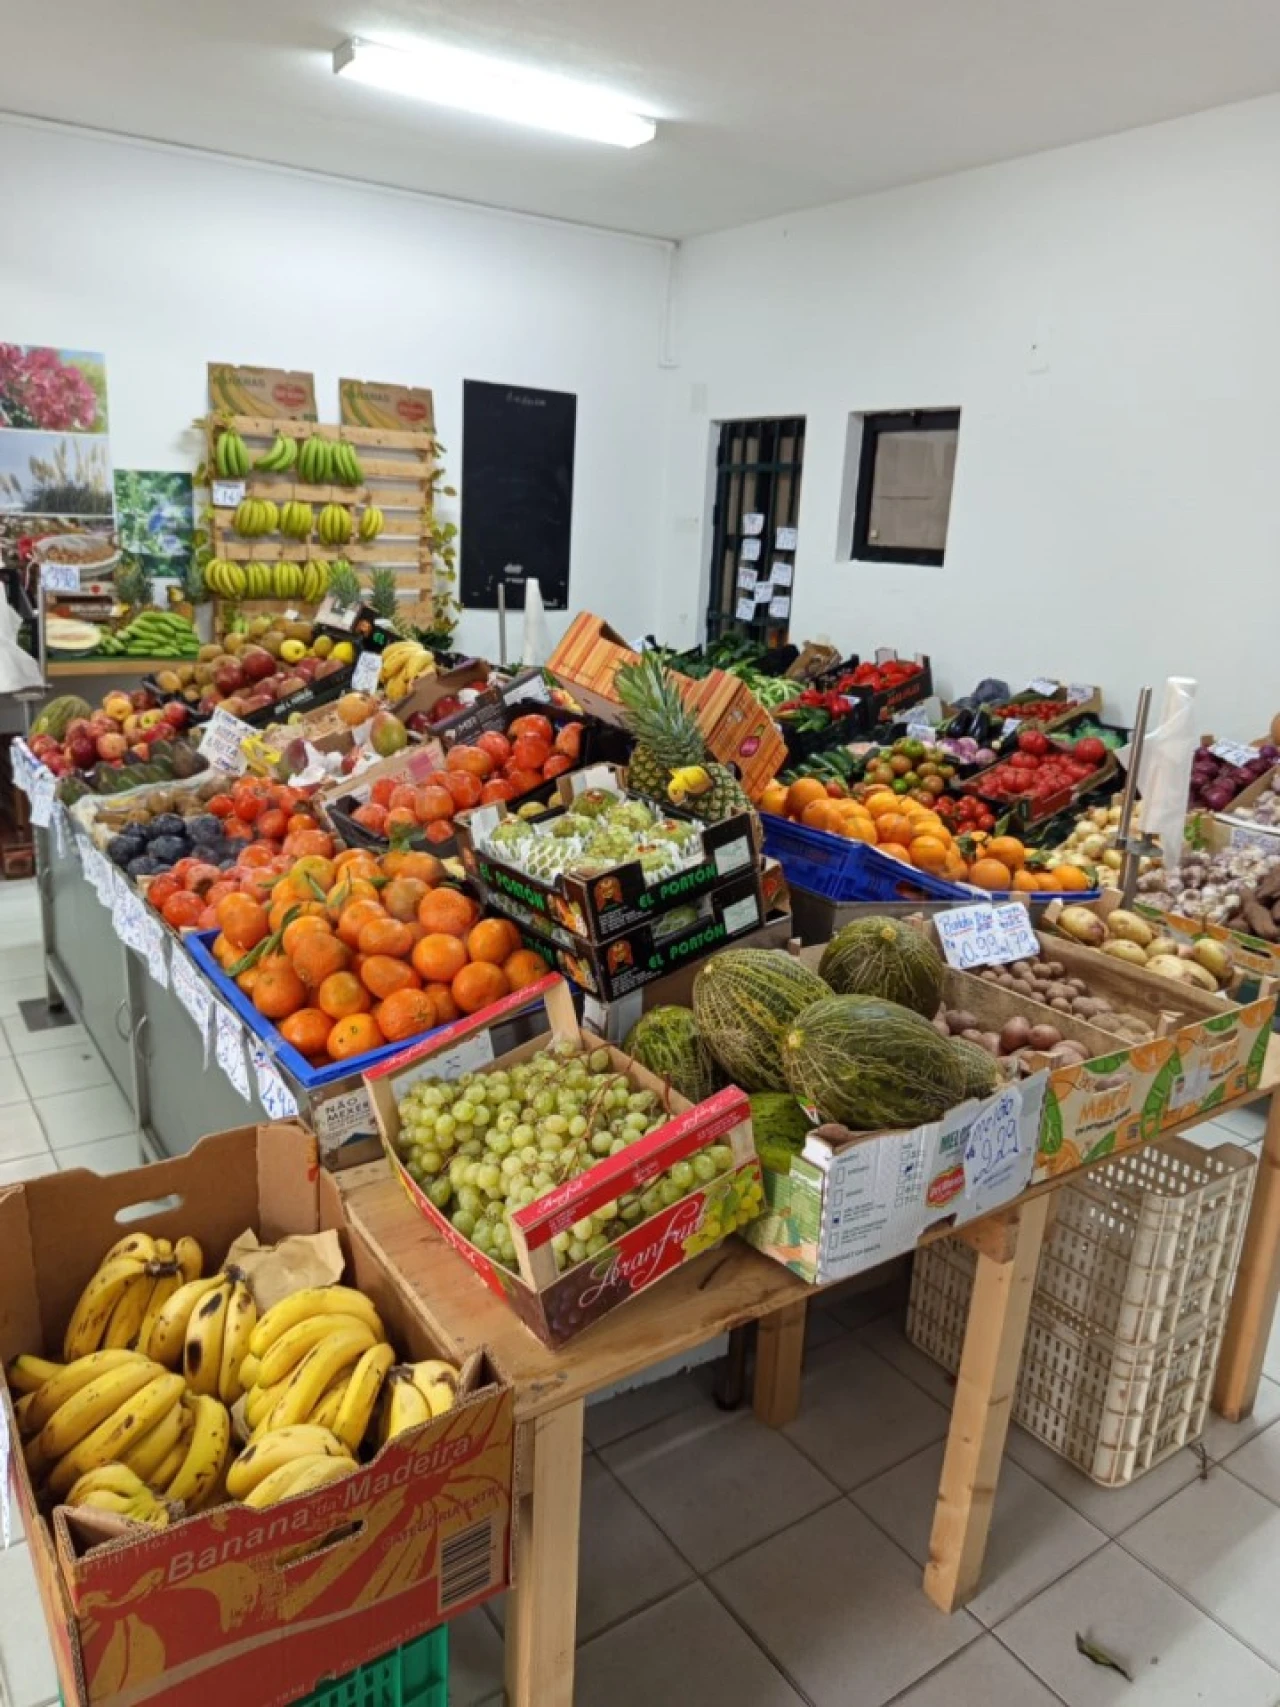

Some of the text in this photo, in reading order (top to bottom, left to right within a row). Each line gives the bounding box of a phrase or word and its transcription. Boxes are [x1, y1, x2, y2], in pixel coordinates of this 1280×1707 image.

[639, 893, 654, 908] EL
[648, 954, 664, 968] EL
[168, 1508, 308, 1583] Banana
[343, 1436, 473, 1510] Madeira
